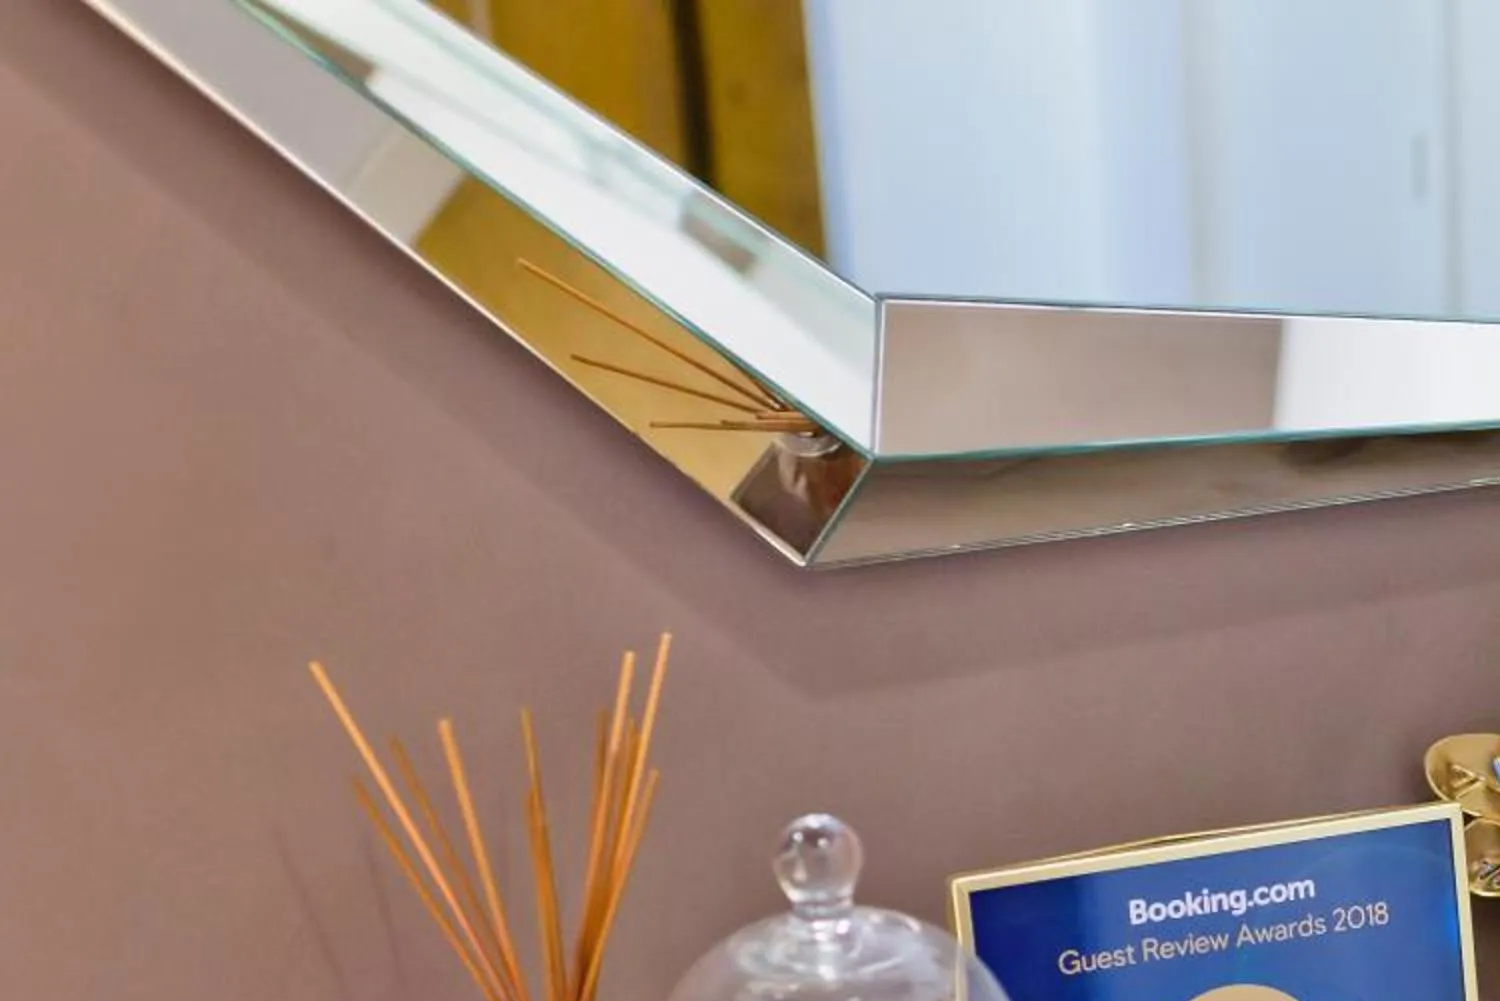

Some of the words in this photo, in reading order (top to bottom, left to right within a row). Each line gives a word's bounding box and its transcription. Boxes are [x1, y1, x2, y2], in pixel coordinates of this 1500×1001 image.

[1129, 876, 1316, 926] Booking.com
[1058, 944, 1136, 976] Guest
[1143, 932, 1229, 962] Review
[1237, 913, 1327, 946] Awards
[1334, 902, 1390, 932] 2018
